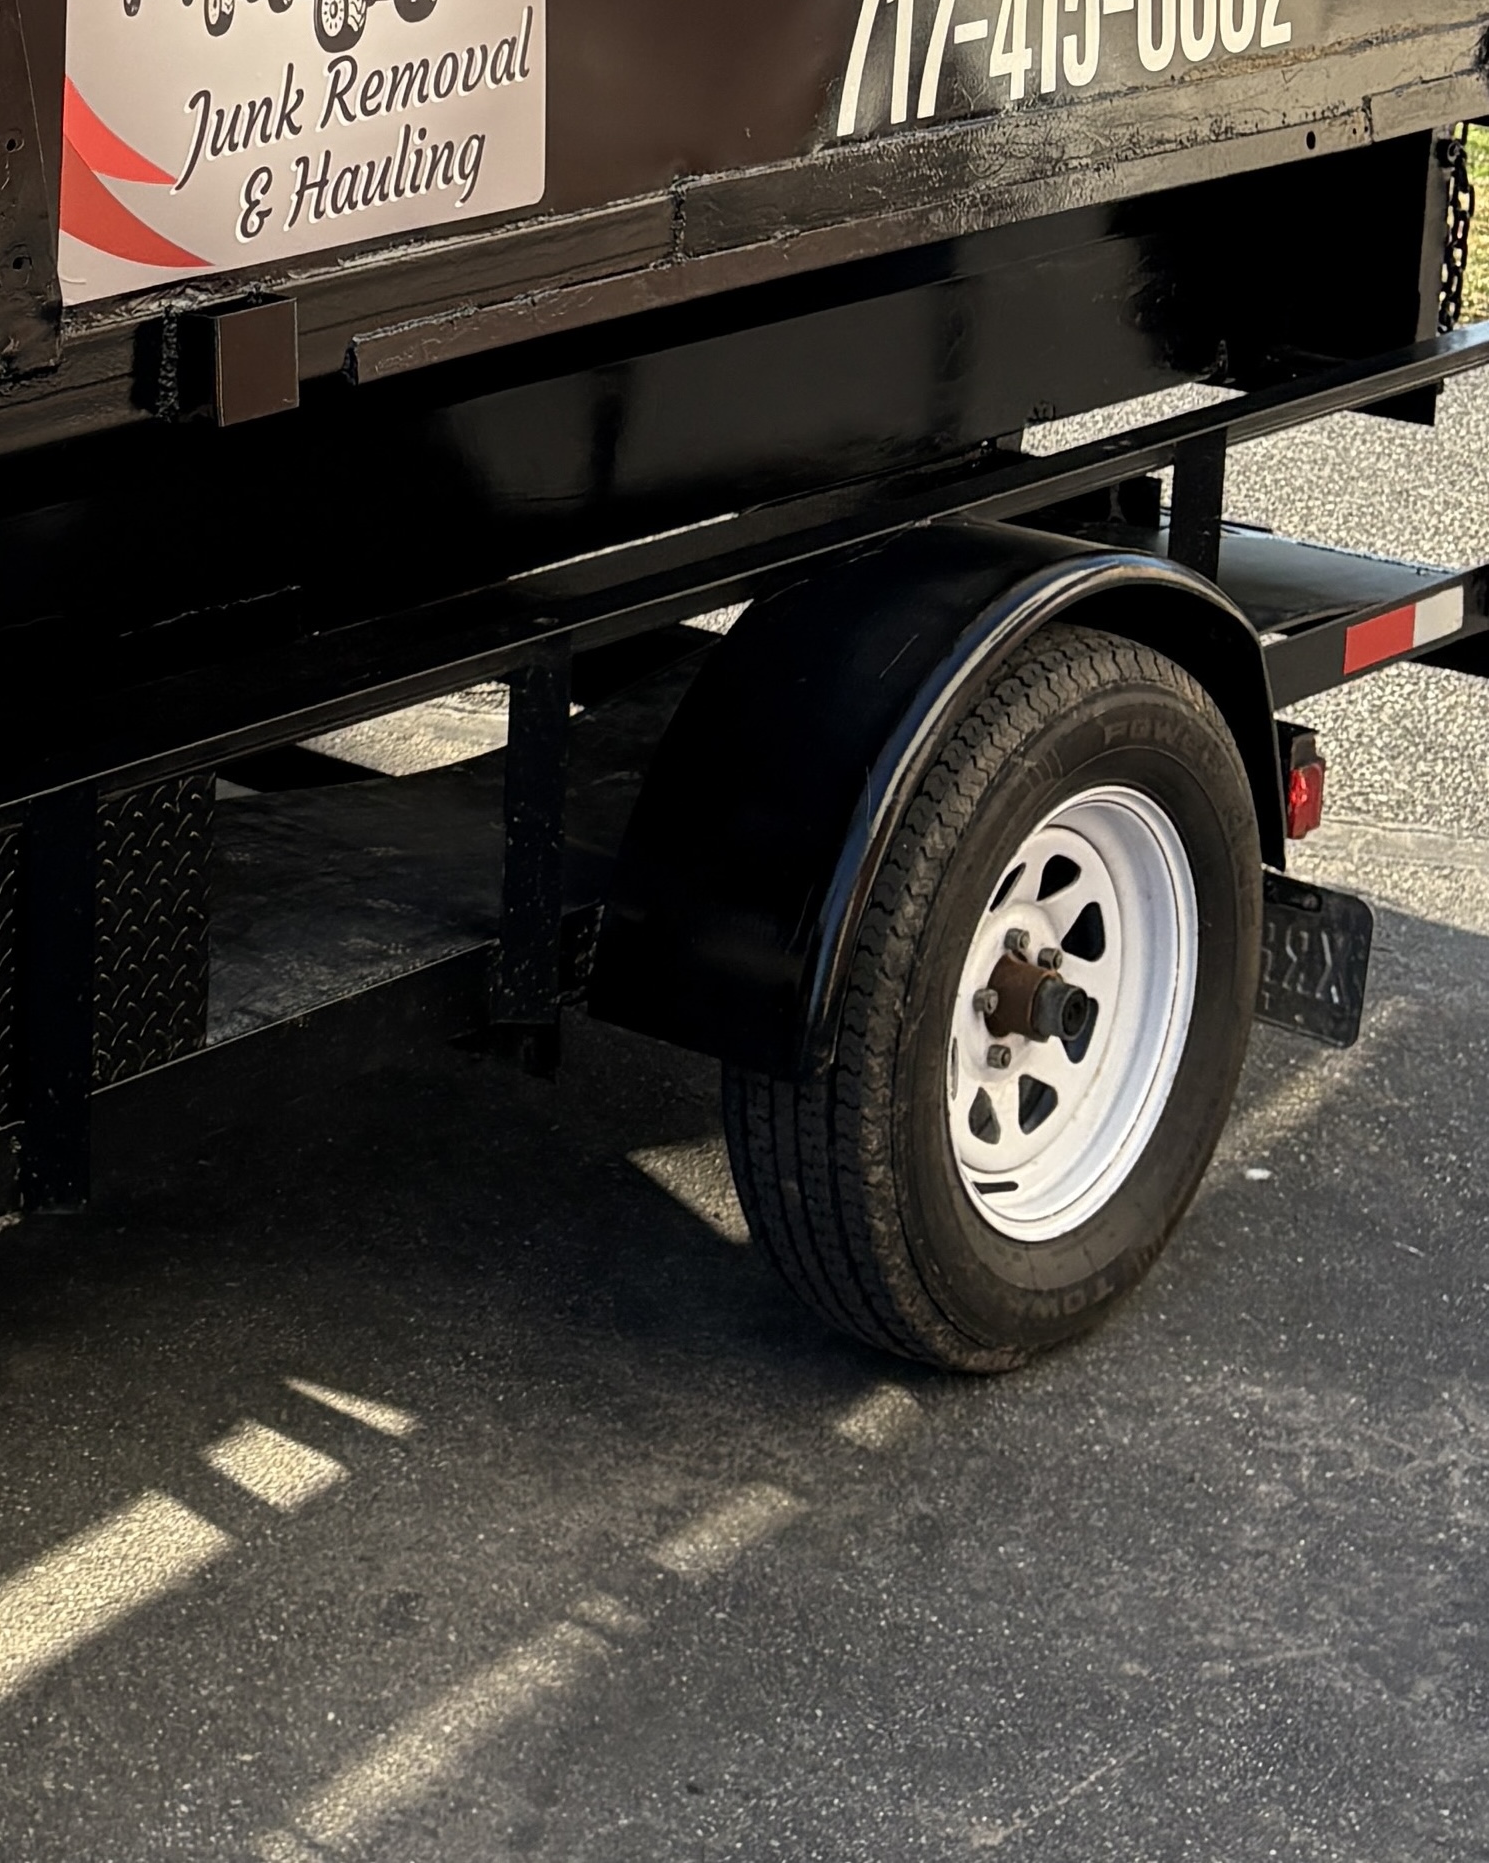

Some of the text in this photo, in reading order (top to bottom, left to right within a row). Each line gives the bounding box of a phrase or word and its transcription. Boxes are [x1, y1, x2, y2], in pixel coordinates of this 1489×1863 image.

[172, 5, 534, 193] Junk Removal
[236, 125, 486, 243] & Hauling
